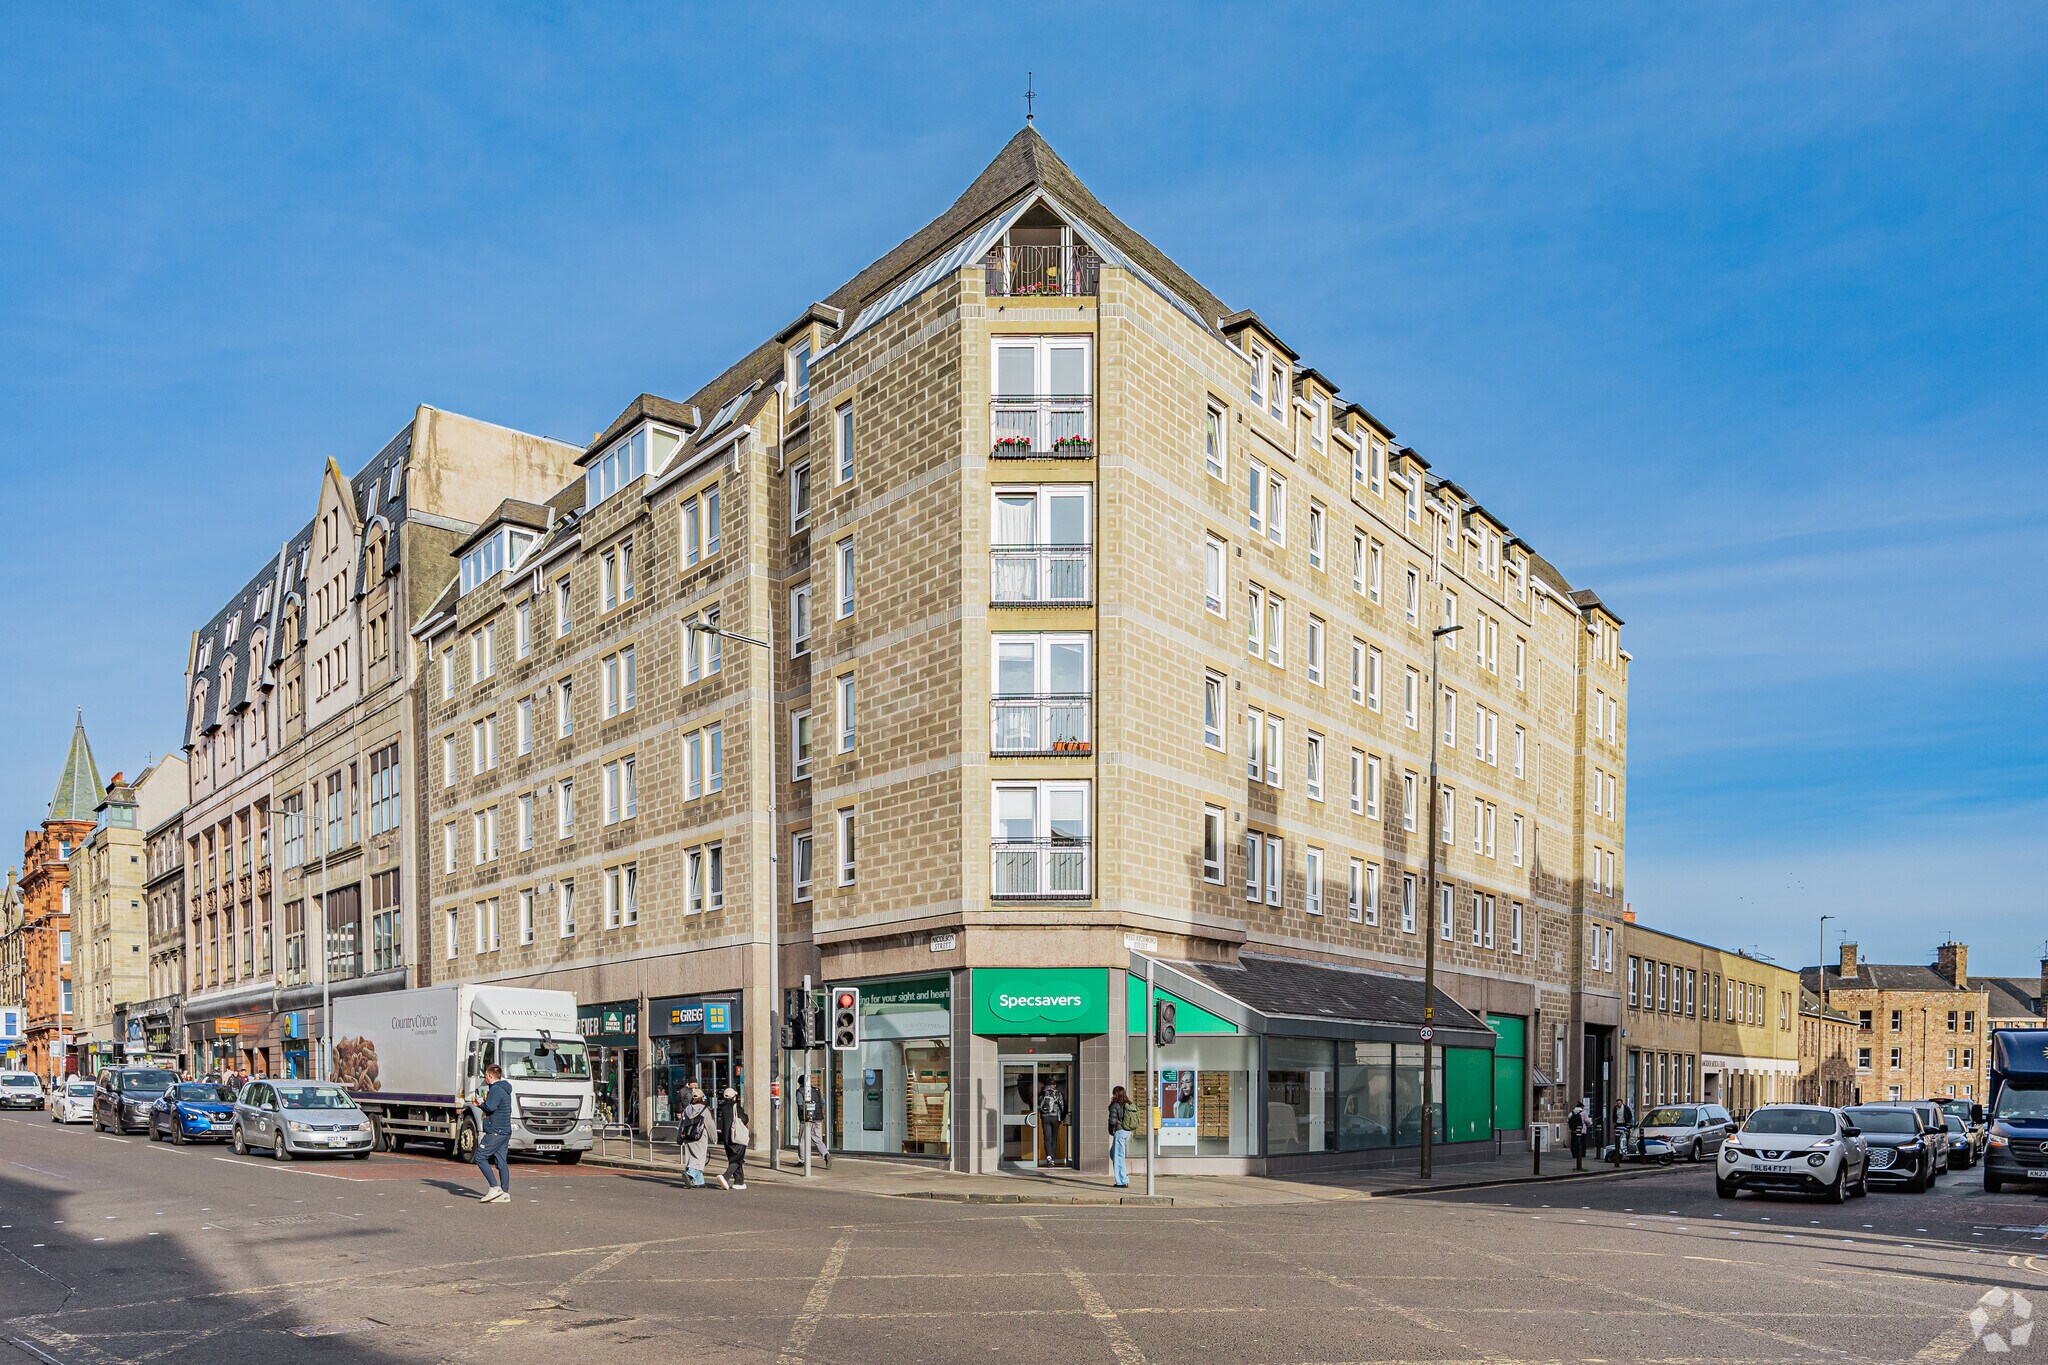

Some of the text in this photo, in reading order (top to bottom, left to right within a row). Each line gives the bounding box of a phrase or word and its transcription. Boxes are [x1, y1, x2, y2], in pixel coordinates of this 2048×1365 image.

[932, 934, 955, 943] NICOLSON
[934, 942, 951, 950] STREET
[871, 994, 881, 1002] for
[882, 994, 897, 1004] your
[899, 991, 915, 1003] sight
[916, 990, 929, 1000] and
[1000, 994, 1082, 1008] Specsavers
[1425, 1008, 1434, 1017] H
